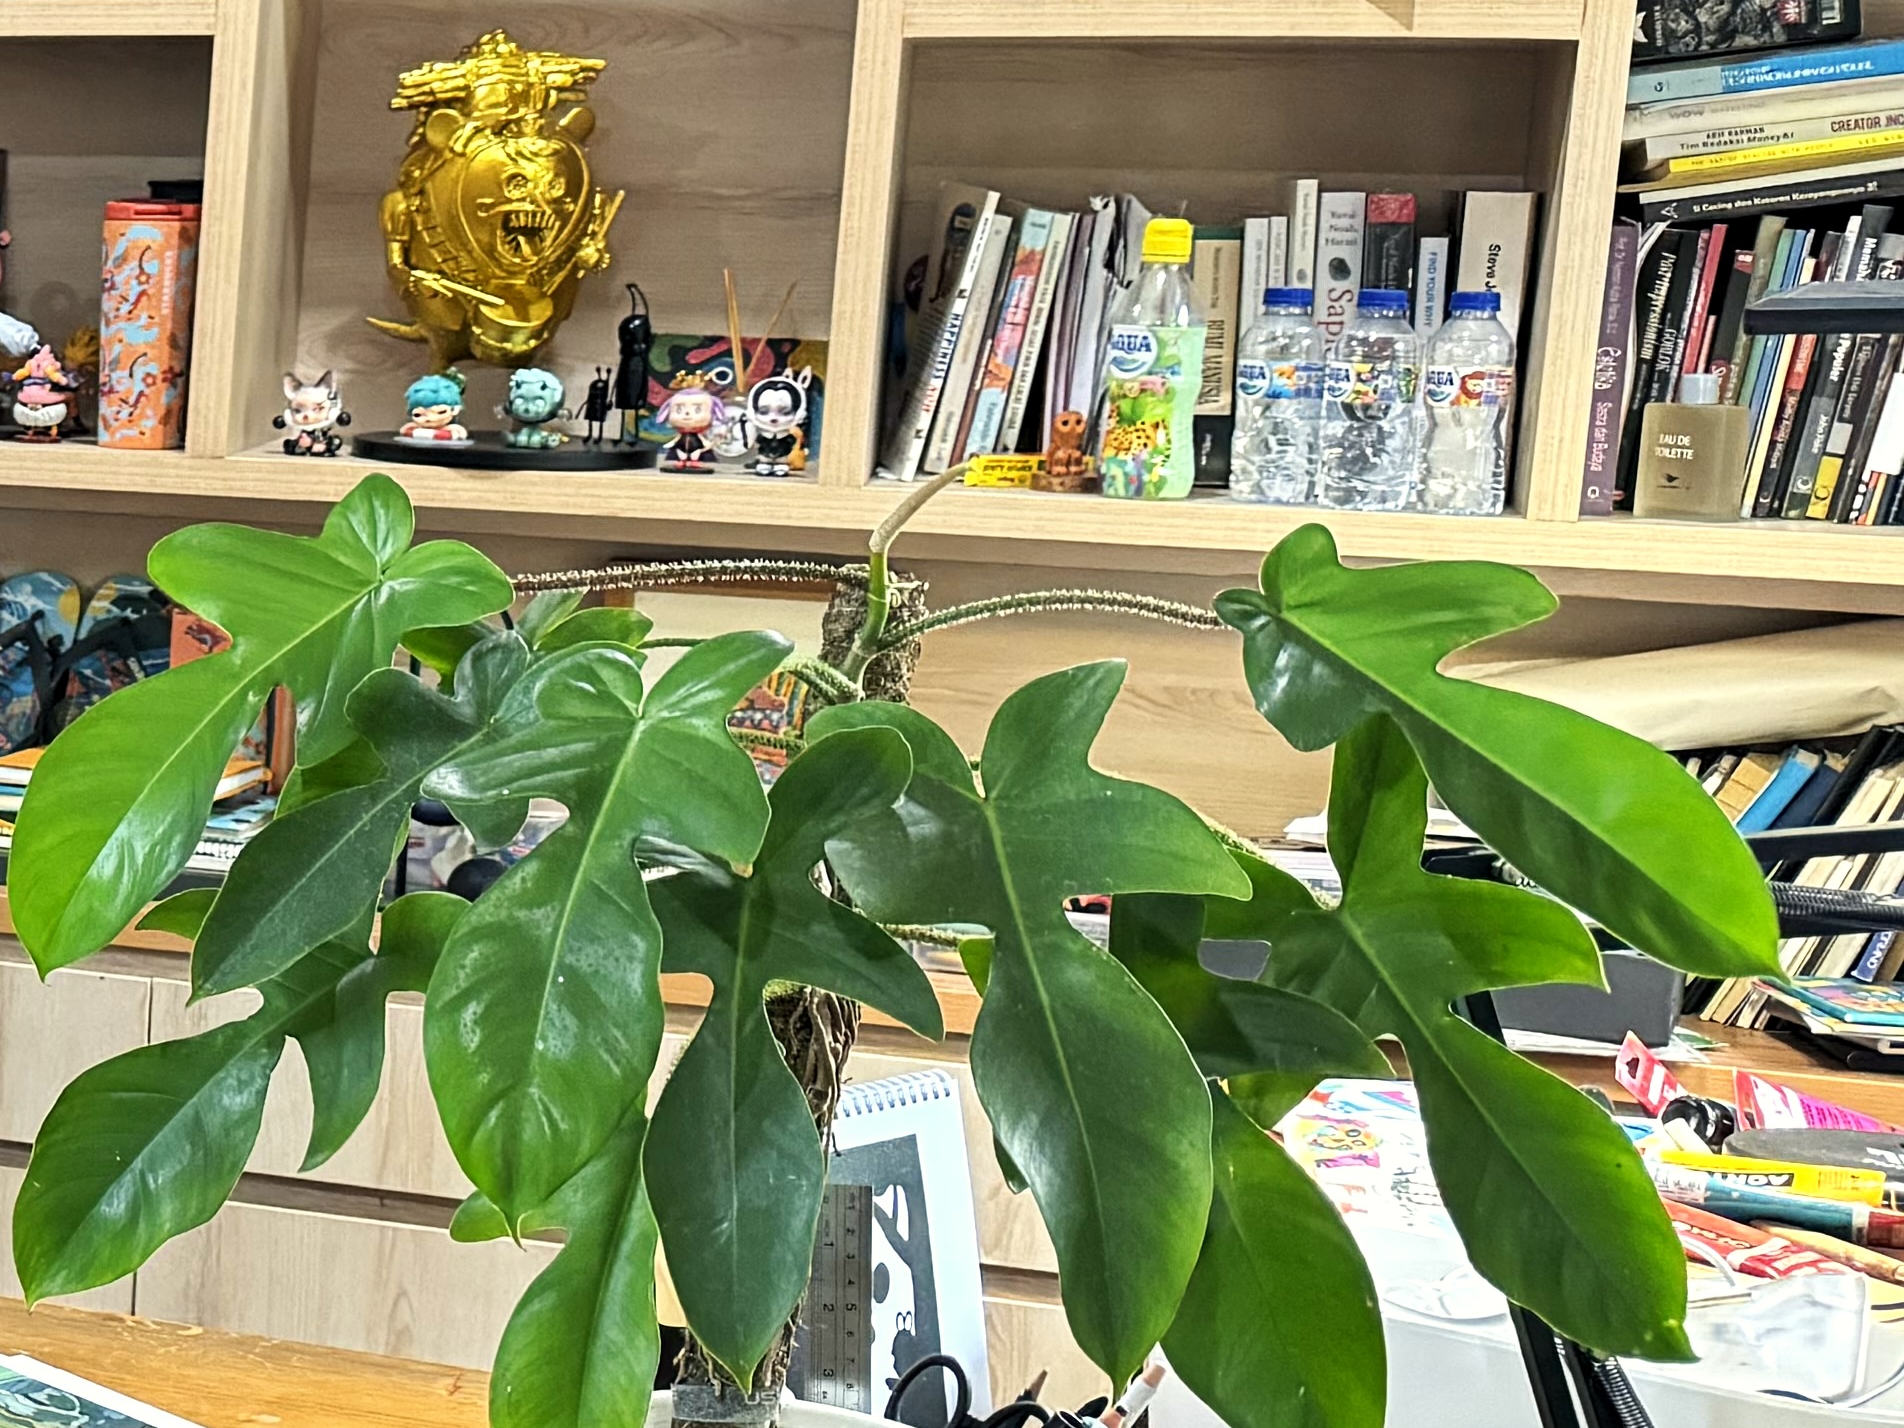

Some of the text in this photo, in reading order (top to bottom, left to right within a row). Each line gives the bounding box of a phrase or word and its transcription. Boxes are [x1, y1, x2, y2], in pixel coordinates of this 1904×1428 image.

[1830, 116, 1882, 133] CREATOR
[1428, 251, 1438, 273] FIND
[1485, 242, 1502, 280] Steve
[932, 312, 962, 380] HAPPINESS
[1678, 434, 1691, 447] DE
